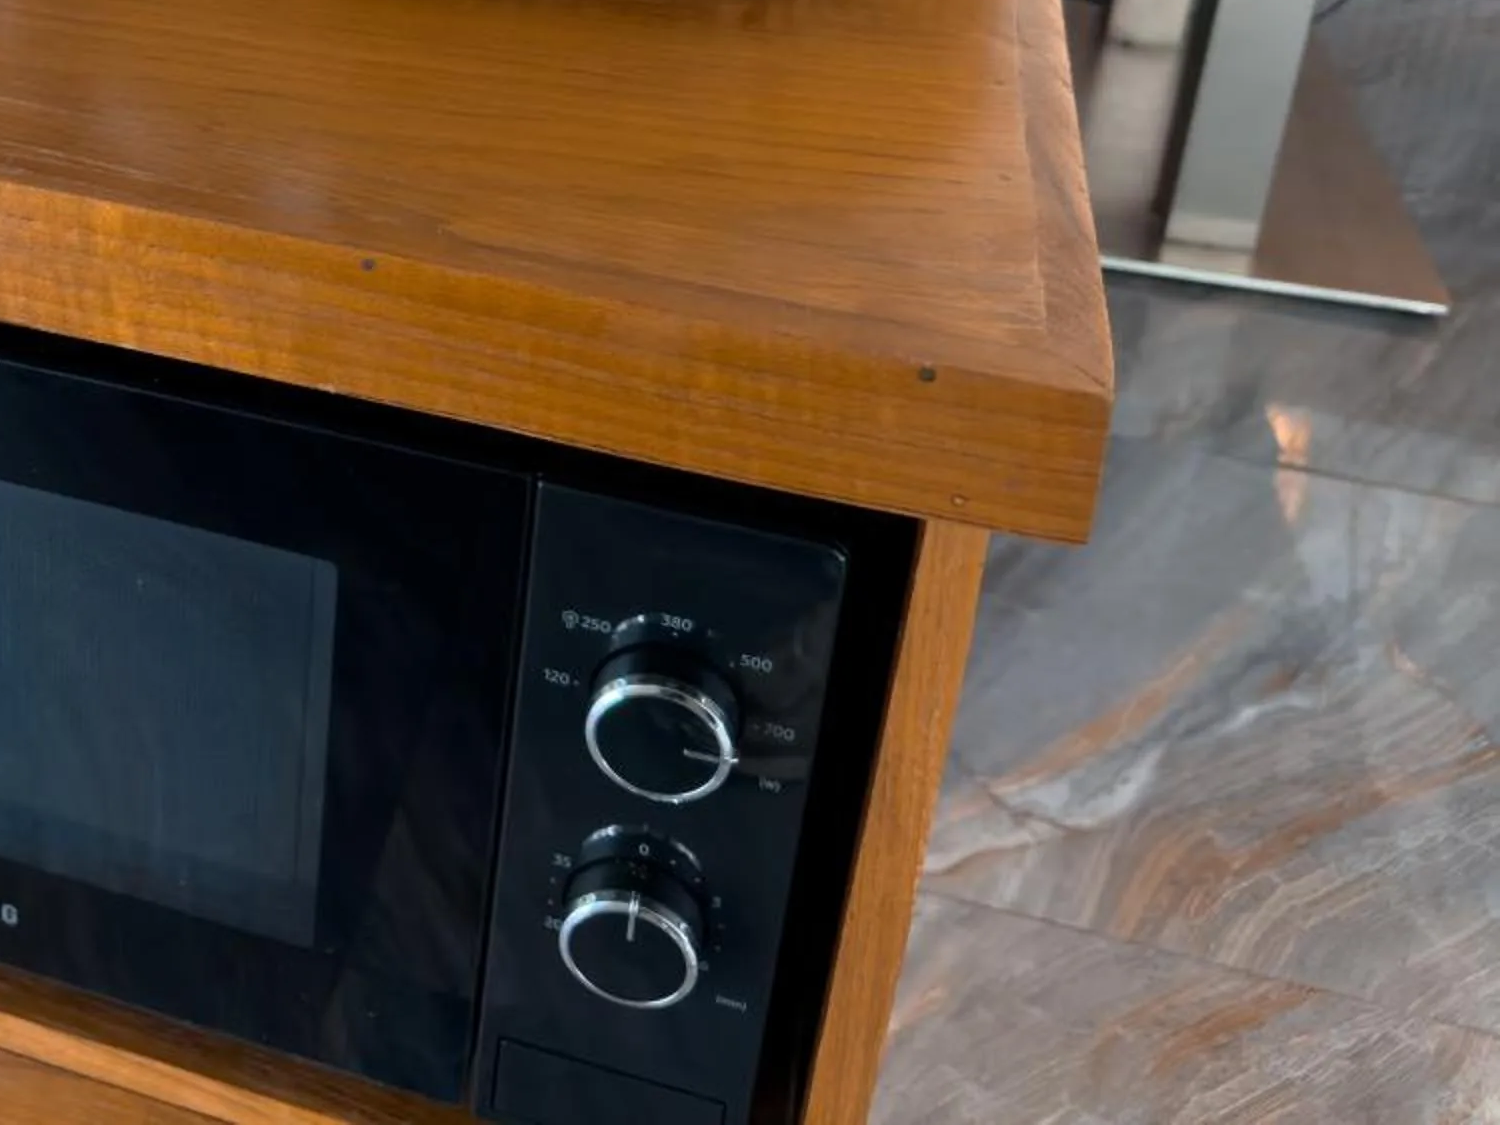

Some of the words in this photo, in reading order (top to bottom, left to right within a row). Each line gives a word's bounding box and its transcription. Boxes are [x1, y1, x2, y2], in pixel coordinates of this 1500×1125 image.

[580, 615, 613, 634] 250
[660, 613, 694, 633] 380
[739, 654, 773, 673] 500
[543, 667, 571, 686] 120
[764, 722, 796, 742] 700
[638, 843, 650, 856] 0
